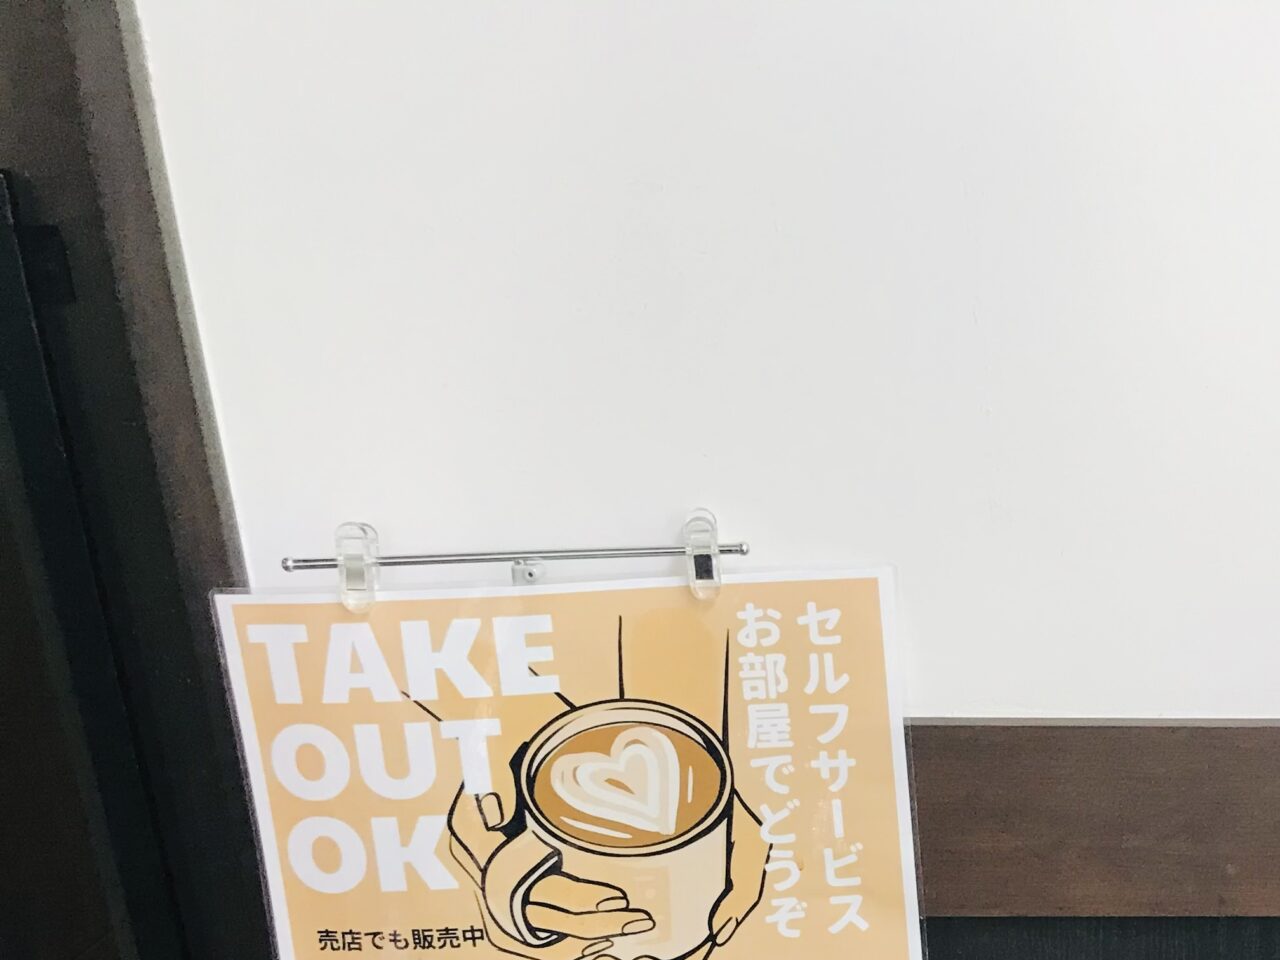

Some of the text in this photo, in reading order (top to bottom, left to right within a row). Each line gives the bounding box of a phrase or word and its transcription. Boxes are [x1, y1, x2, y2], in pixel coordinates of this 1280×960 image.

[246, 614, 560, 704] TAKE
[271, 718, 502, 800] OUT
[737, 603, 807, 938] お部屋でどうぞ
[797, 602, 869, 934] セルフサービス
[287, 815, 460, 893] OK
[317, 925, 485, 951] 売店でも販売中
